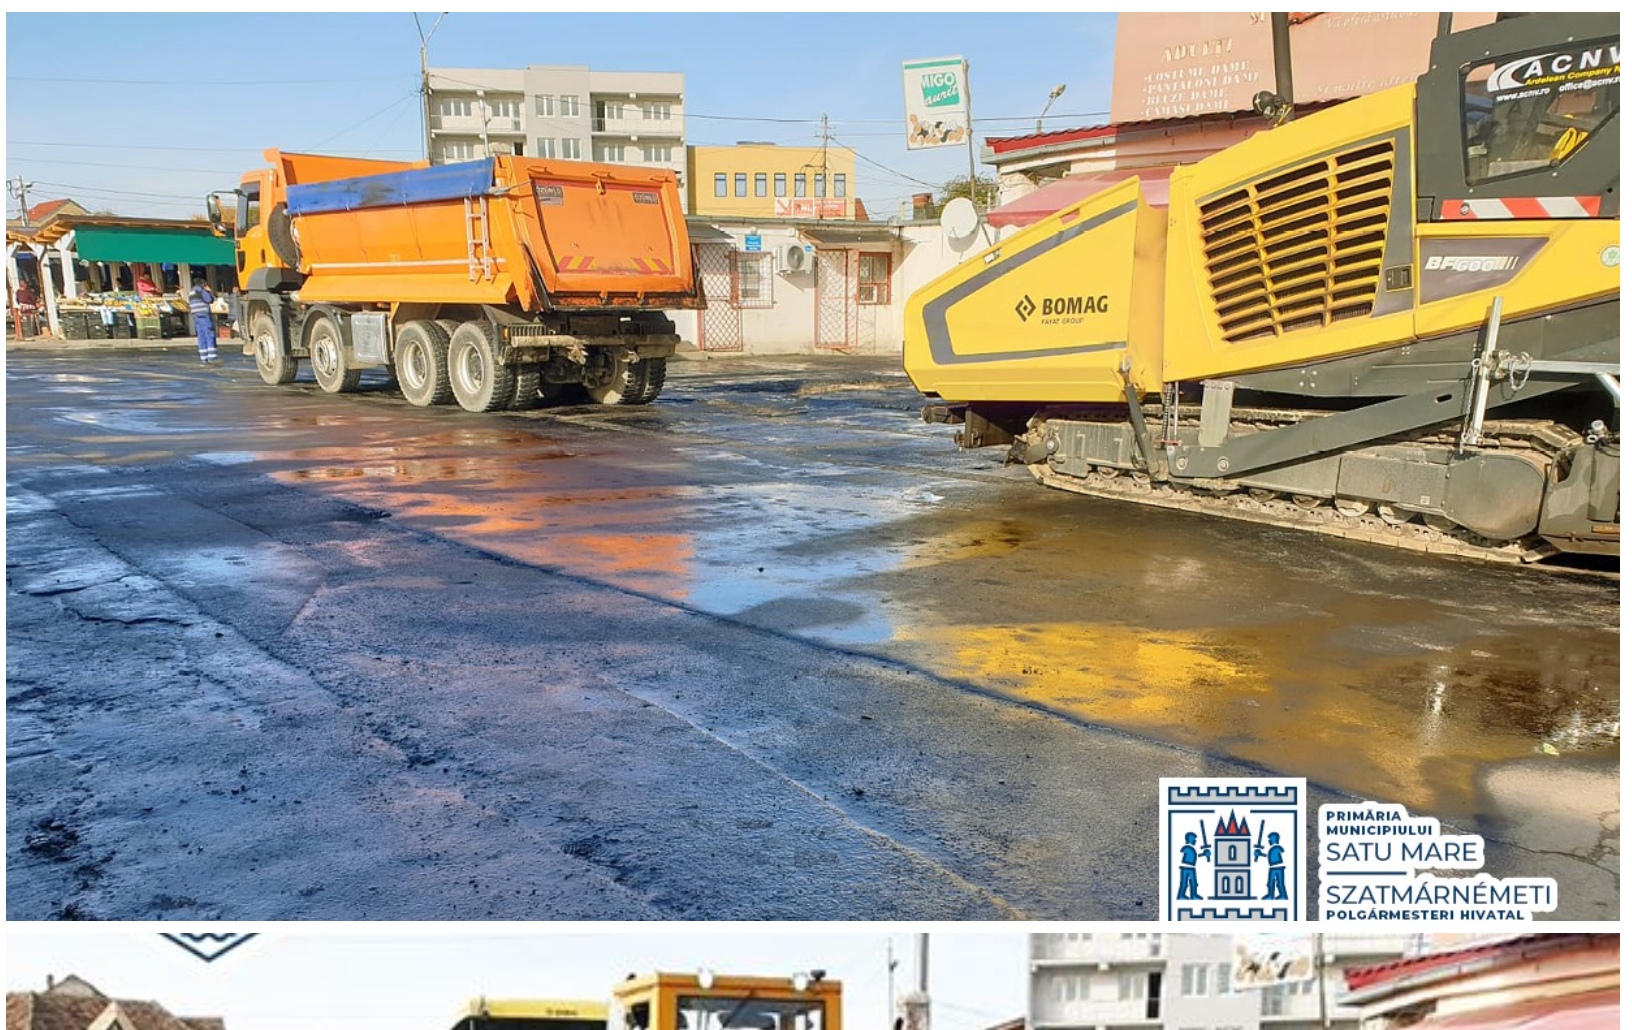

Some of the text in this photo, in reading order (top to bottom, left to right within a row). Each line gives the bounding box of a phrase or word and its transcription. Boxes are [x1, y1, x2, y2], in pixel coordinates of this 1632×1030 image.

[1568, 65, 1612, 80] Company
[1559, 75, 1620, 93] office@acnv.r
[1042, 295, 1108, 316] BOMAG
[1062, 317, 1084, 325] GROUP
